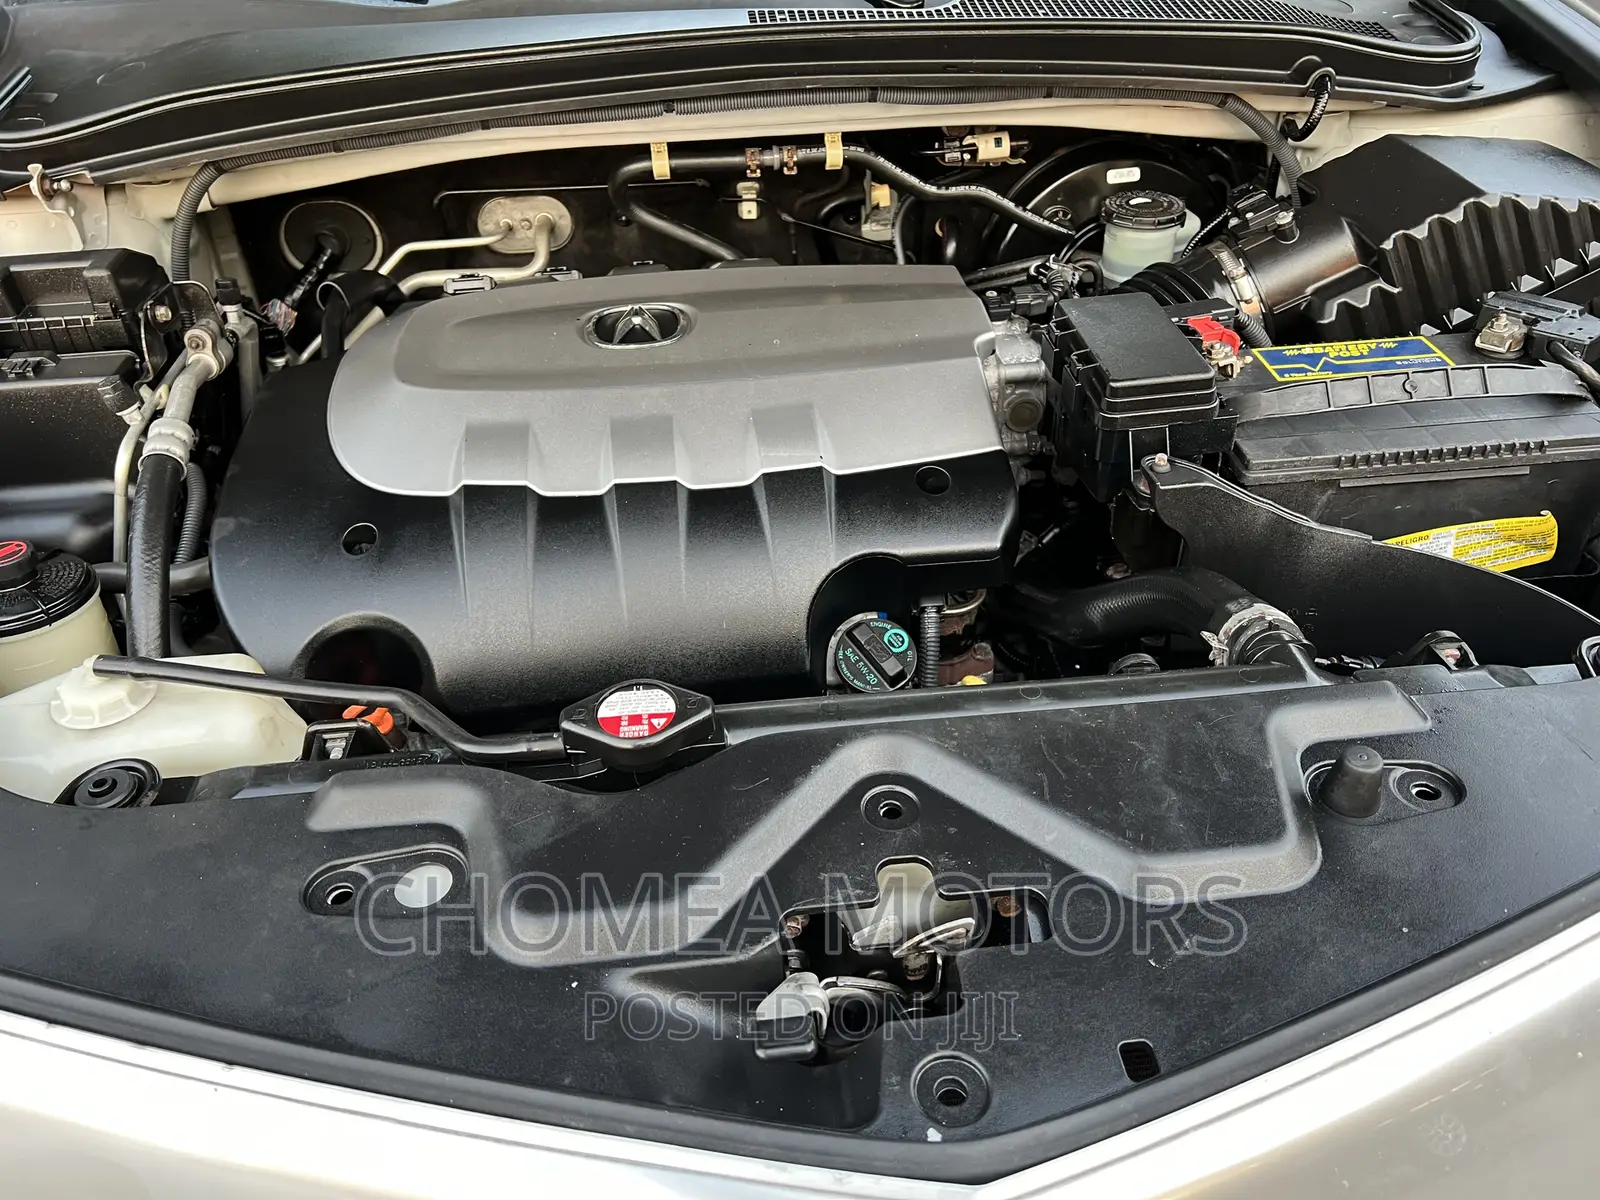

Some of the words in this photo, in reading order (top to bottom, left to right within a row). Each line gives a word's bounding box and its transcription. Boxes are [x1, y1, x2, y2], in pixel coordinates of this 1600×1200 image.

[870, 621, 892, 630] ENGINE
[845, 647, 859, 663] SAE
[856, 661, 878, 685] 5W-20
